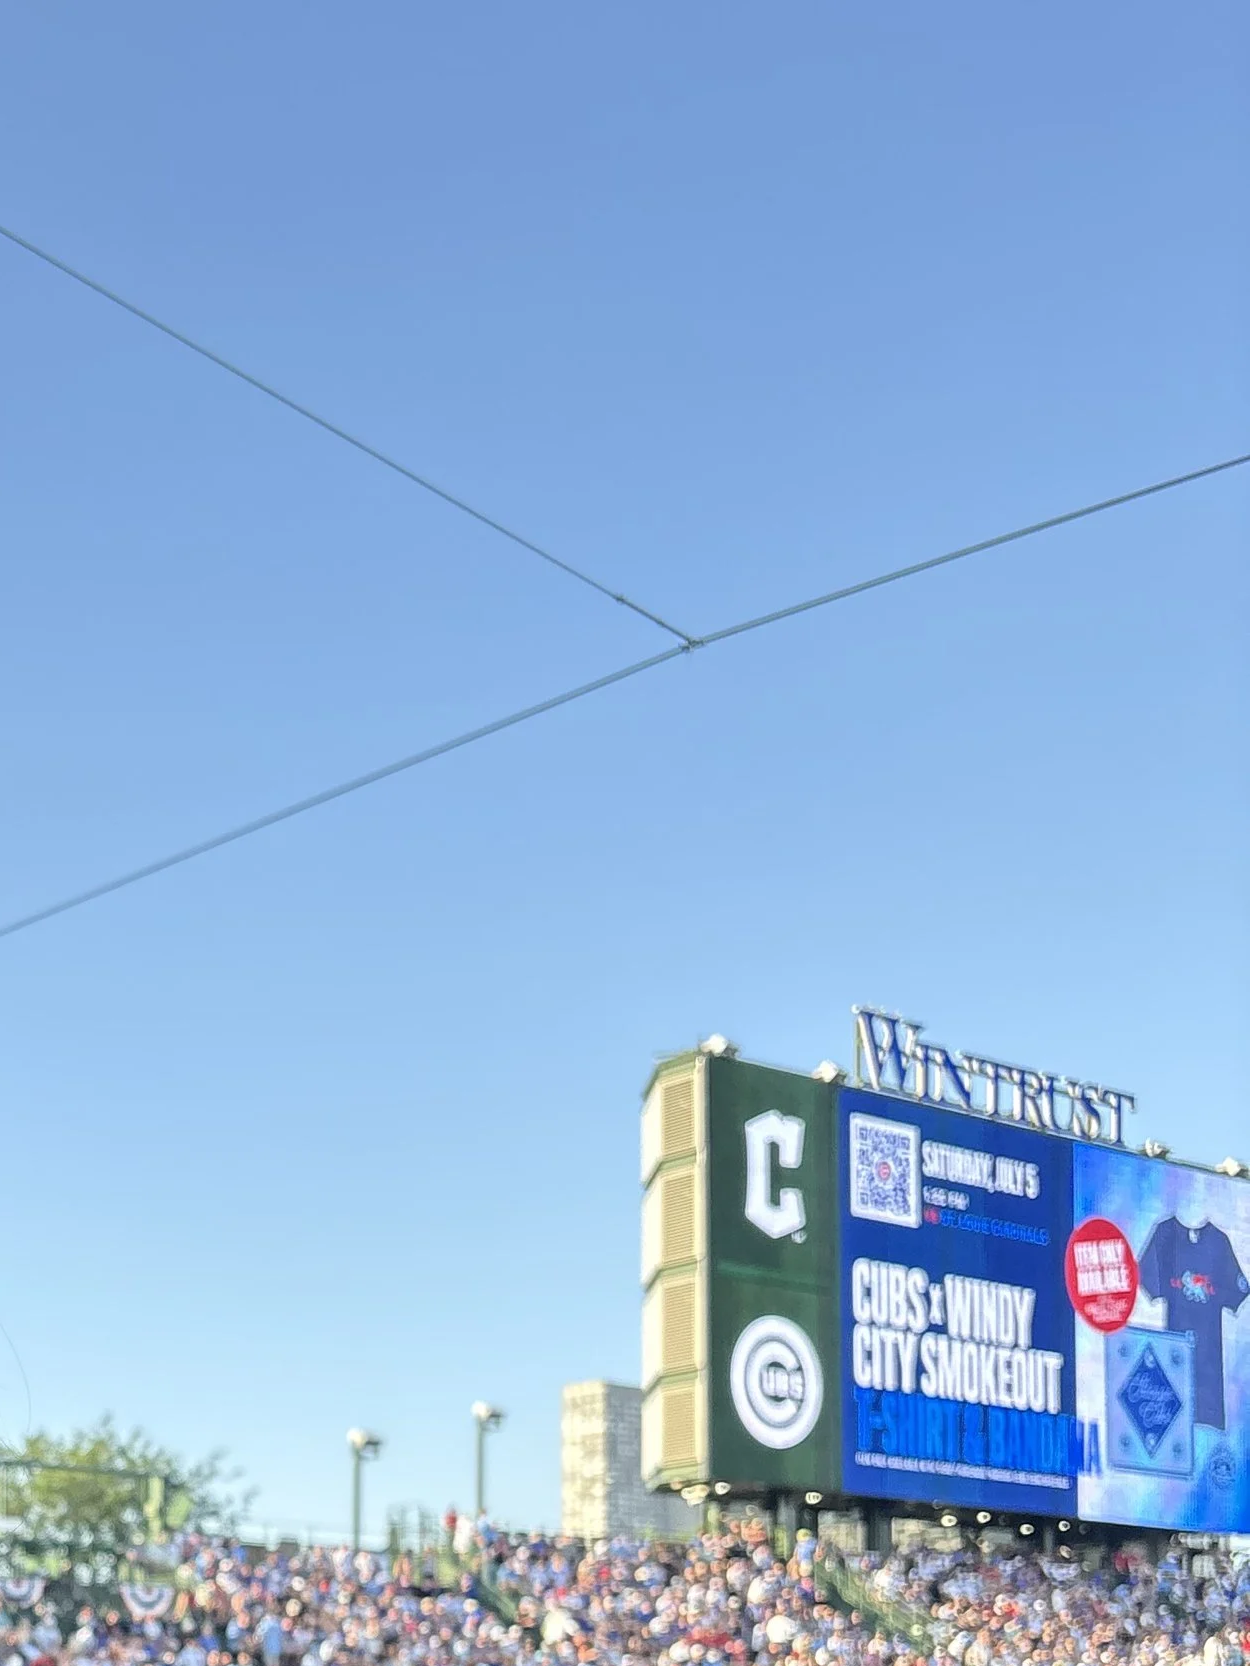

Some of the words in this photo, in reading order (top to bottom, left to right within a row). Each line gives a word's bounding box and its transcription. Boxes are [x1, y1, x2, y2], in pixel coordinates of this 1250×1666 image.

[851, 1008, 1135, 1146] WINTRUST
[1025, 1163, 1040, 1199] 5
[852, 1257, 930, 1334] CUBS
[944, 1273, 1037, 1350] WINDY
[852, 1322, 920, 1394] CITY
[920, 1331, 1065, 1415] SMOKEOUT
[853, 1385, 960, 1461] T-SHIRT
[987, 1406, 1103, 1478] BANDANA
